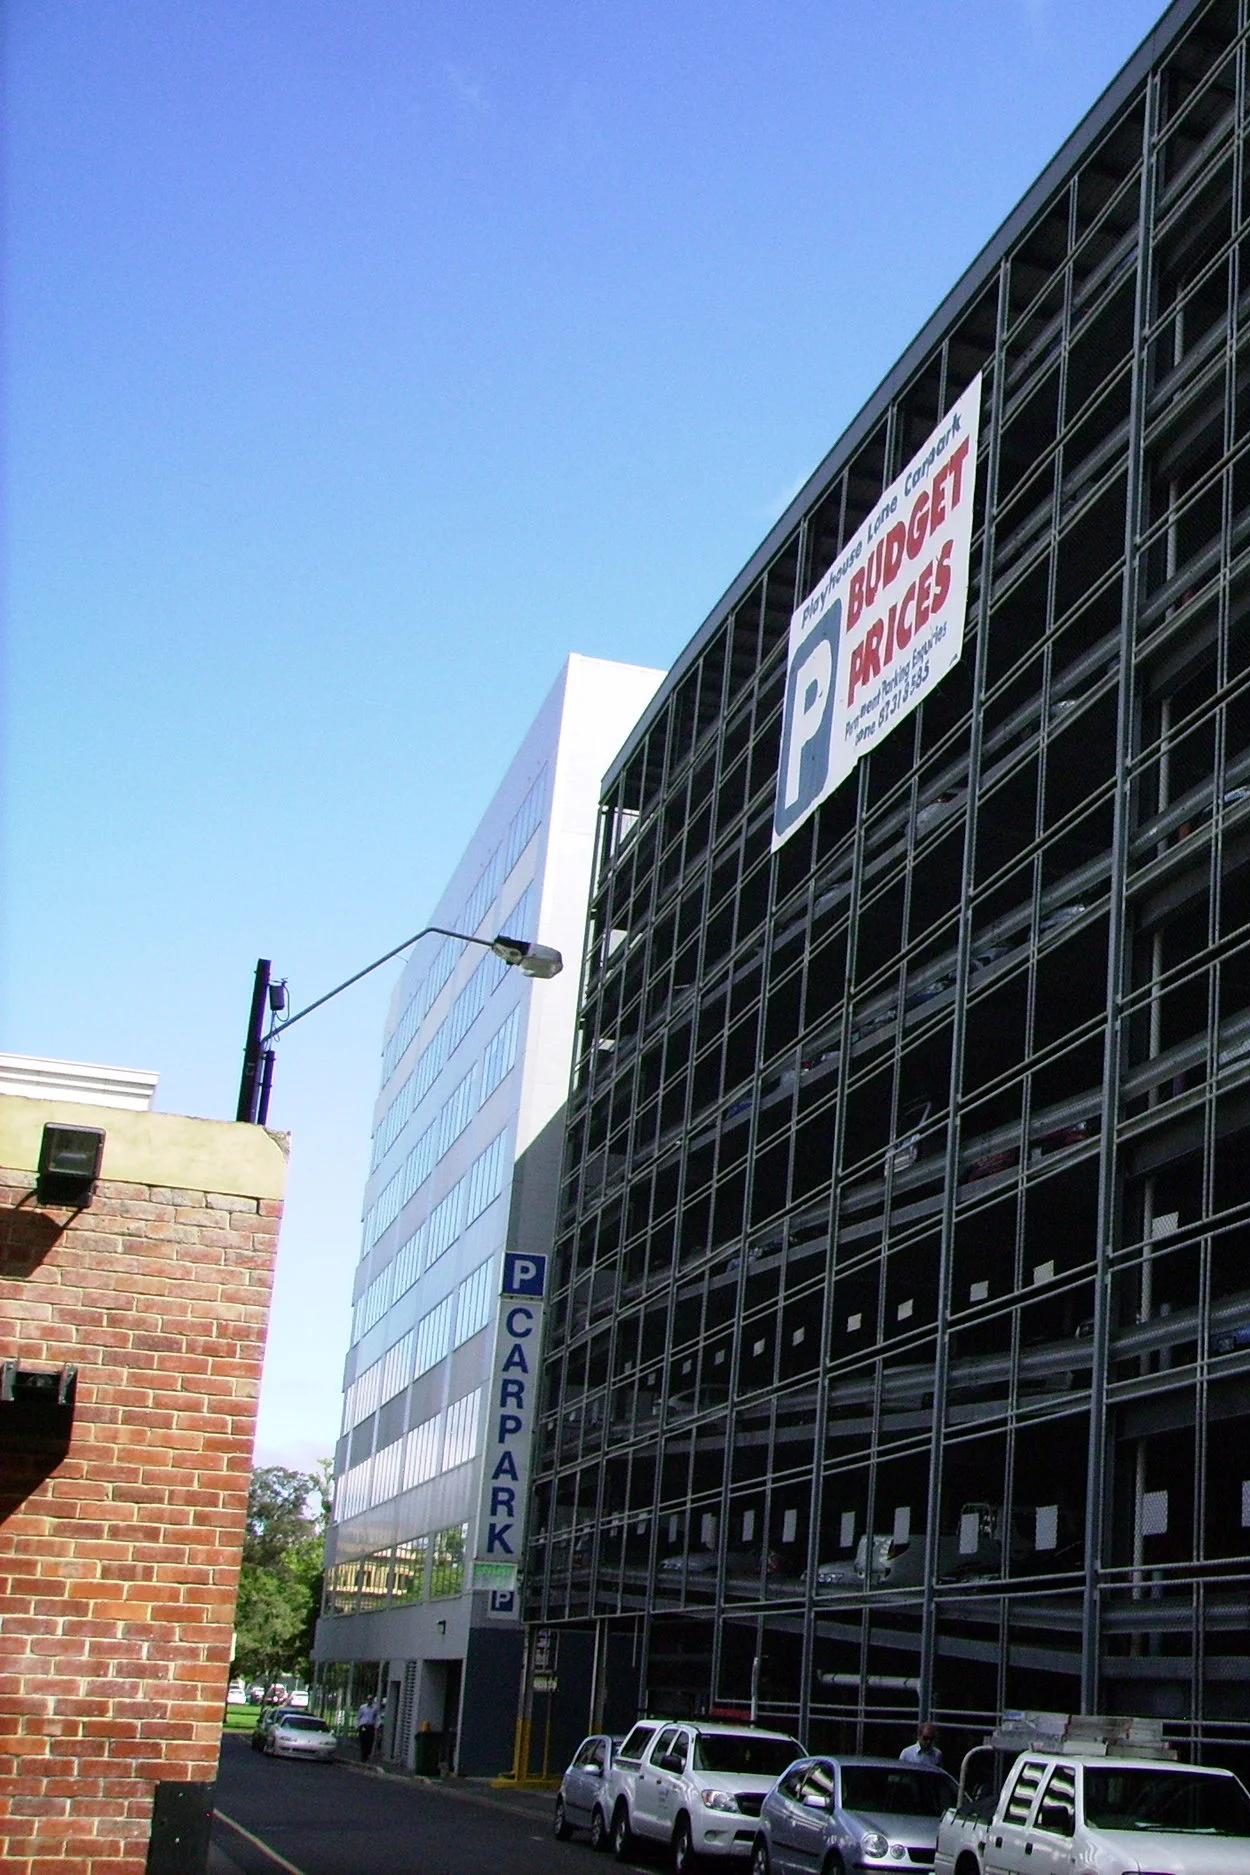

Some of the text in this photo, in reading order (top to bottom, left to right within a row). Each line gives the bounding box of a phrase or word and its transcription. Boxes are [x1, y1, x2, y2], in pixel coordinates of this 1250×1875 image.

[802, 412, 961, 629] Playhouse Lane Carpark
[846, 434, 970, 634] BUDGET
[847, 539, 954, 709] PRICES
[785, 639, 832, 810] P
[512, 1260, 537, 1289] P
[486, 1307, 534, 1554] CARPARK
[495, 1591, 511, 1608] P
